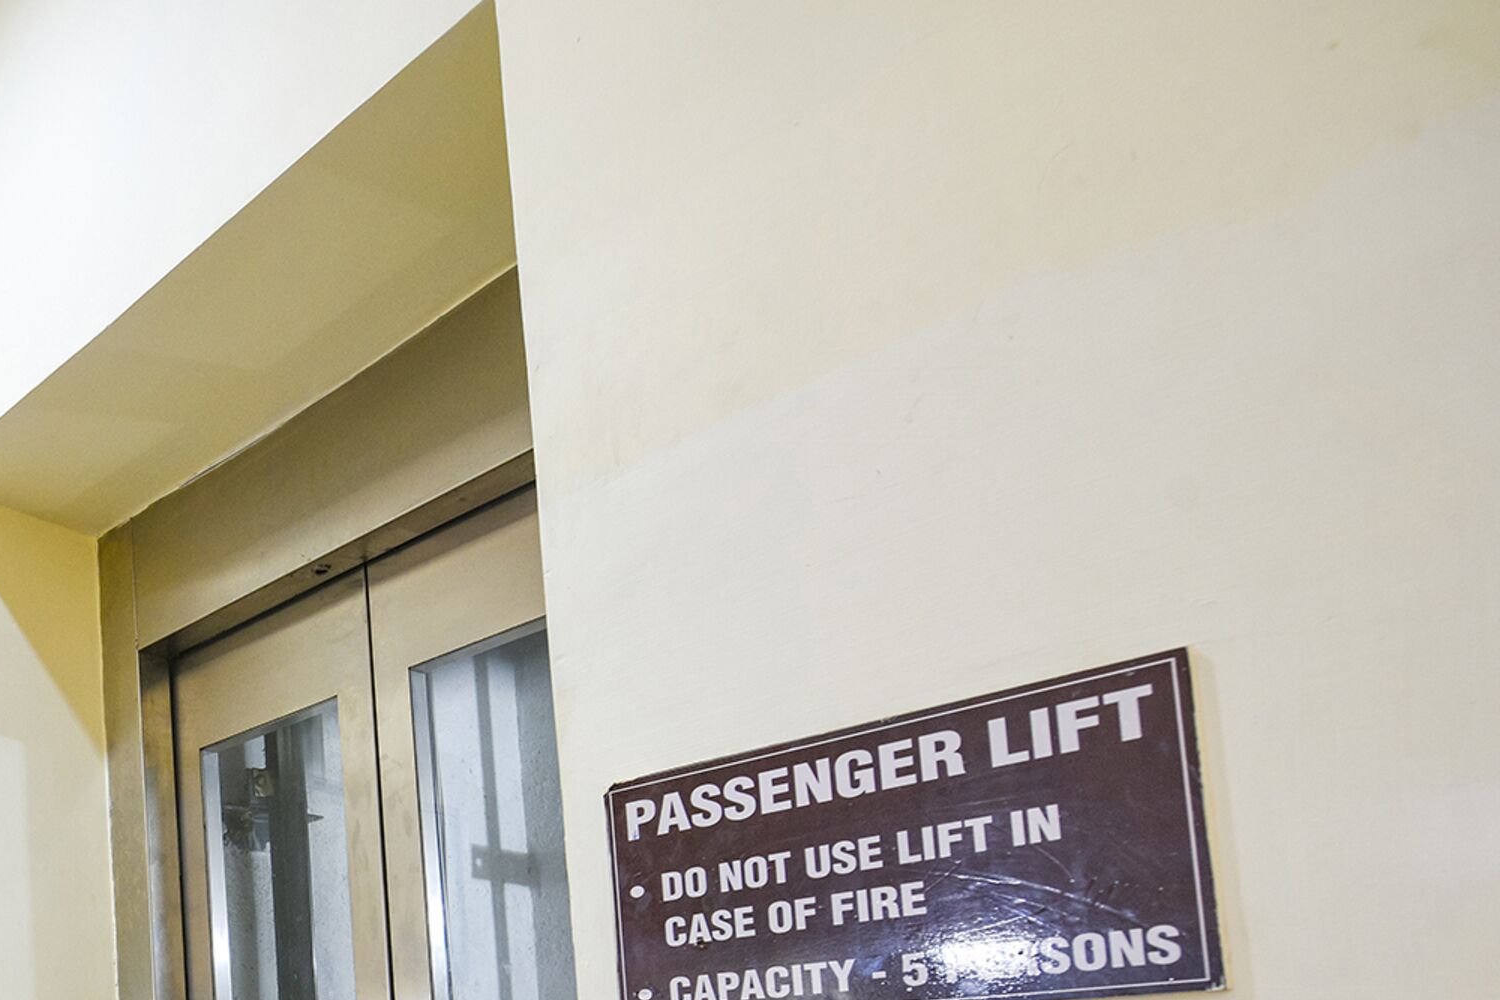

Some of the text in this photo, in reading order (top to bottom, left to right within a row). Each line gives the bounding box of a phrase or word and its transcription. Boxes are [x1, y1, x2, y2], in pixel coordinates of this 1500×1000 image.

[625, 683, 1154, 842] PASSENGER LIFT
[660, 803, 1063, 903] DO NOT USE LIFT IN
[663, 881, 928, 948] CASE OF FIRE
[902, 952, 929, 987] 5
[944, 924, 1182, 984] SONS
